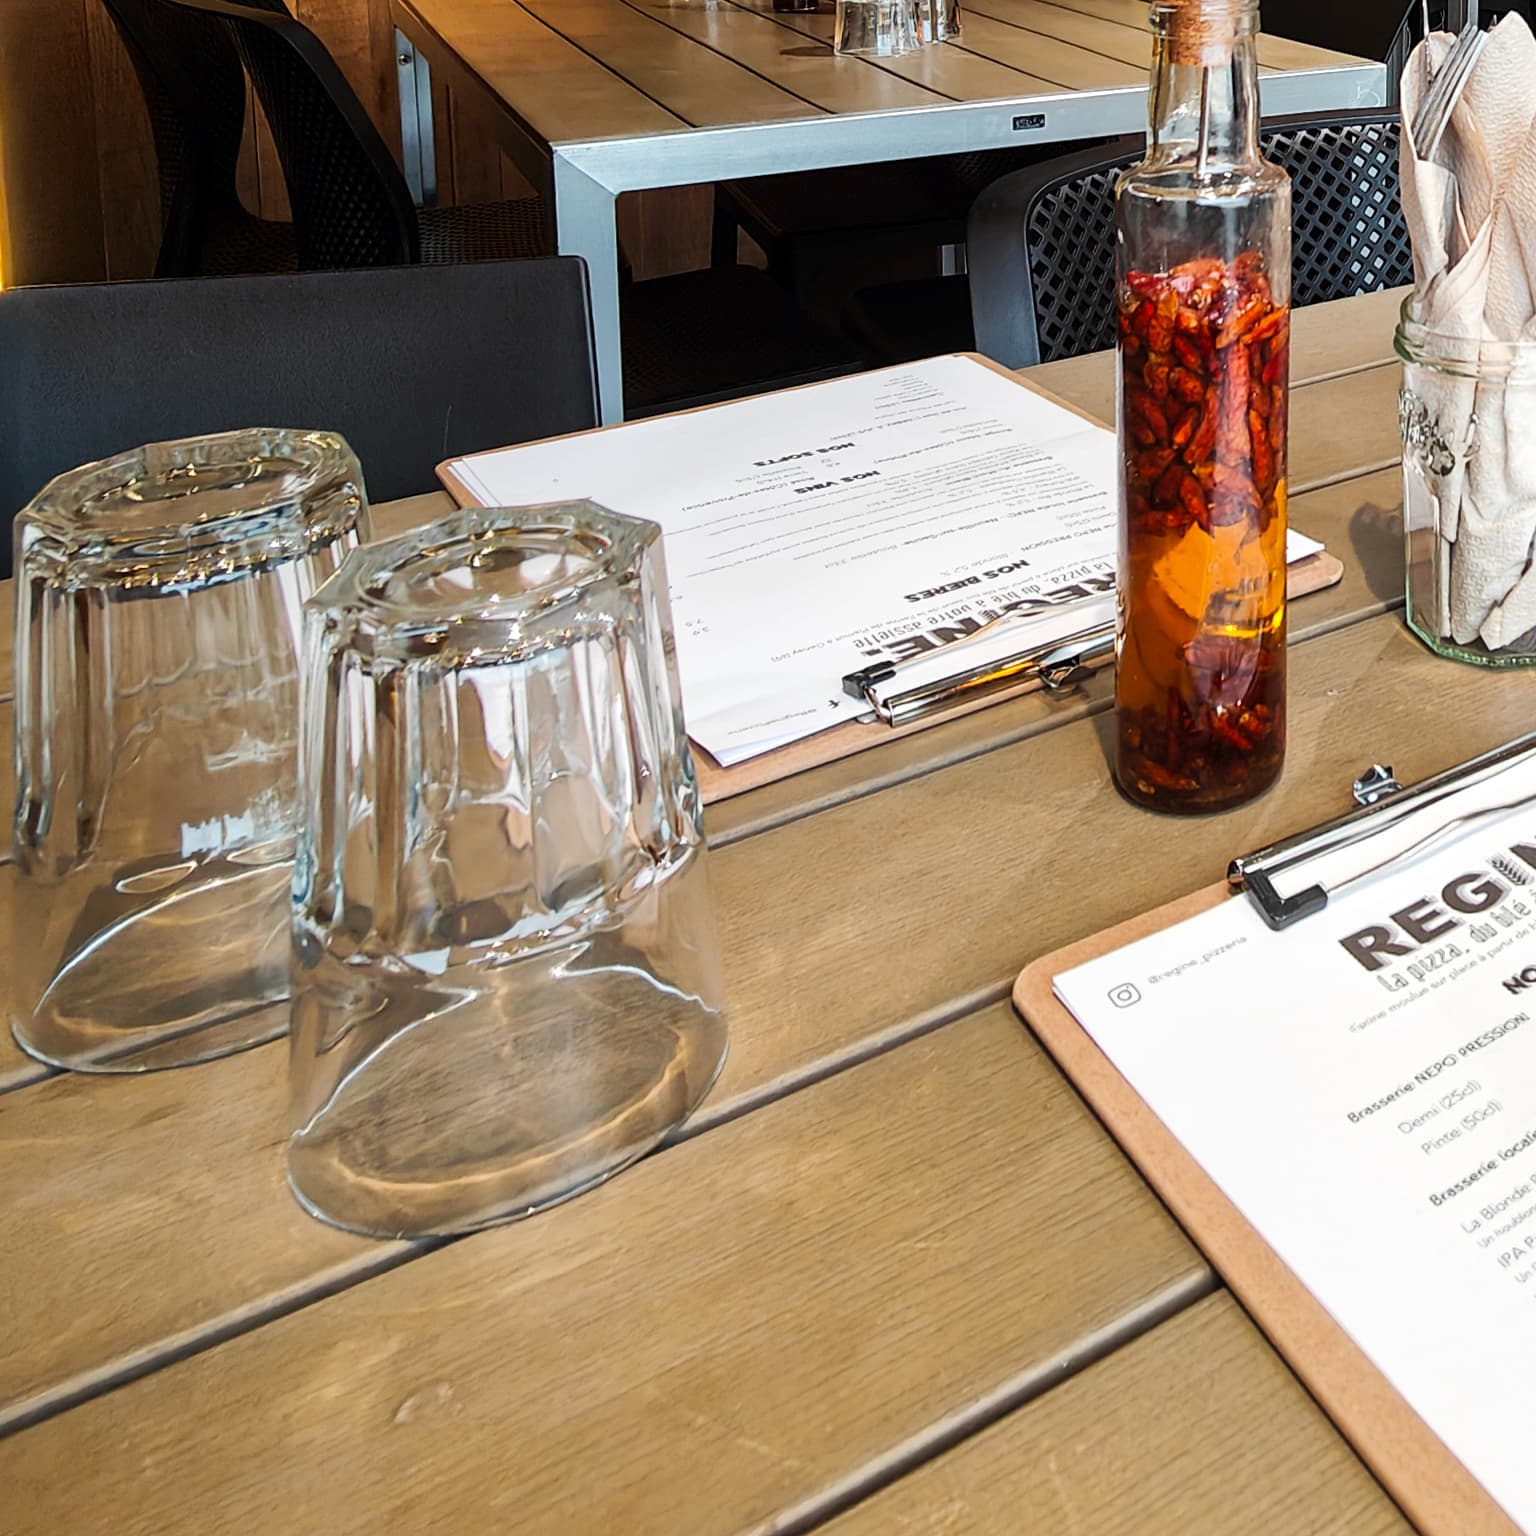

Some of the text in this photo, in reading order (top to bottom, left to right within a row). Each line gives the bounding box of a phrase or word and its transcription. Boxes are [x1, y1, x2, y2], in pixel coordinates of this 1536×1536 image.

[815, 441, 856, 454] NOS
[839, 470, 881, 483] NOS
[904, 559, 1031, 603] NOS BIERES
[1347, 1082, 1415, 1124] Brasserie
[1414, 1054, 1459, 1084] NEPO
[1429, 1160, 1499, 1207] Brasserie
[1497, 1247, 1527, 1268] IPA
